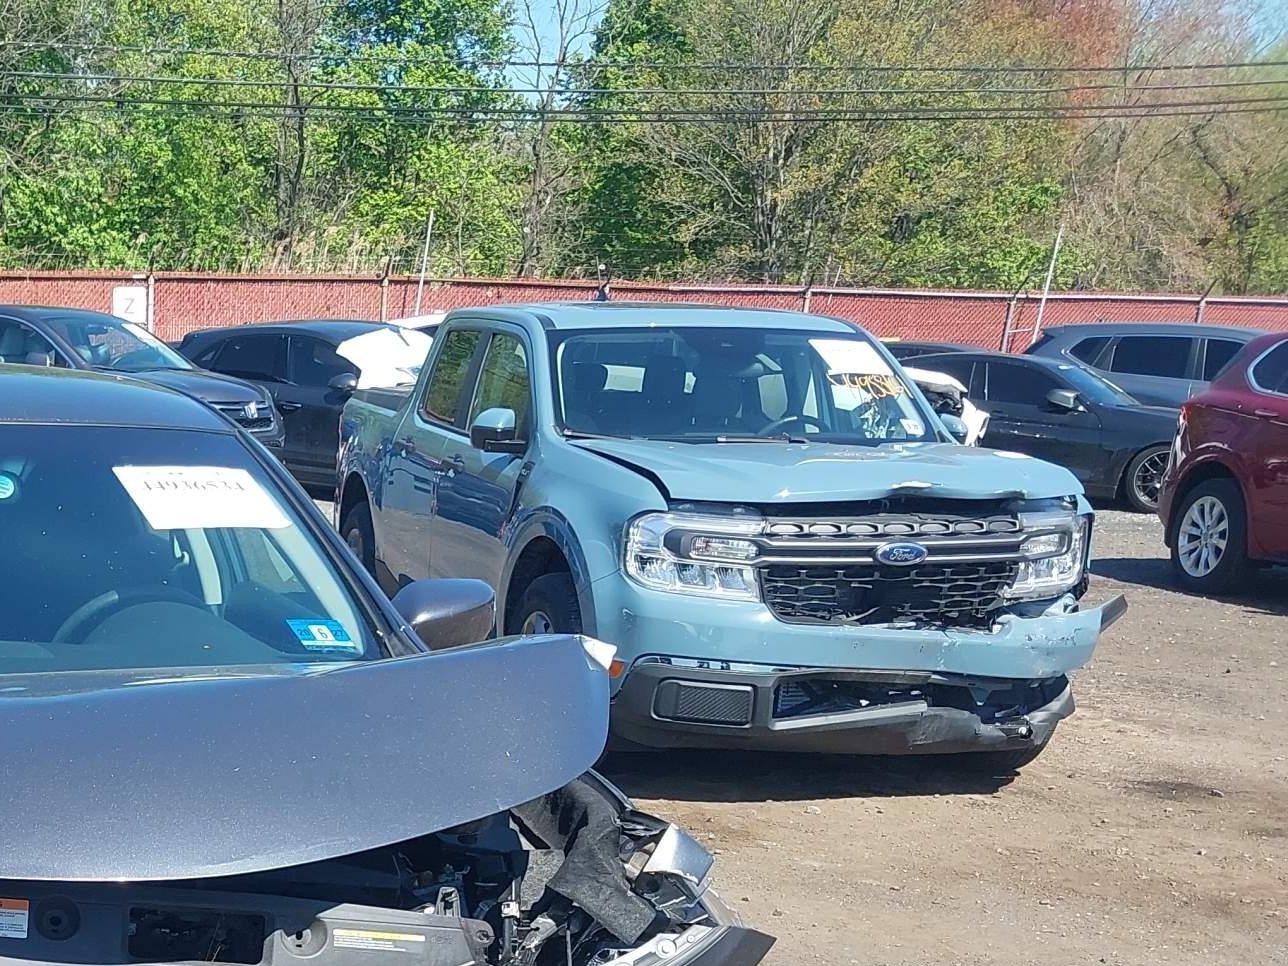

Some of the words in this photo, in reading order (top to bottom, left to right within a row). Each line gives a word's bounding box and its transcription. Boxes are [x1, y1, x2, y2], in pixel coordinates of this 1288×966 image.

[123, 297, 136, 314] Z
[889, 548, 917, 561] Ford
[316, 627, 329, 639] 6
